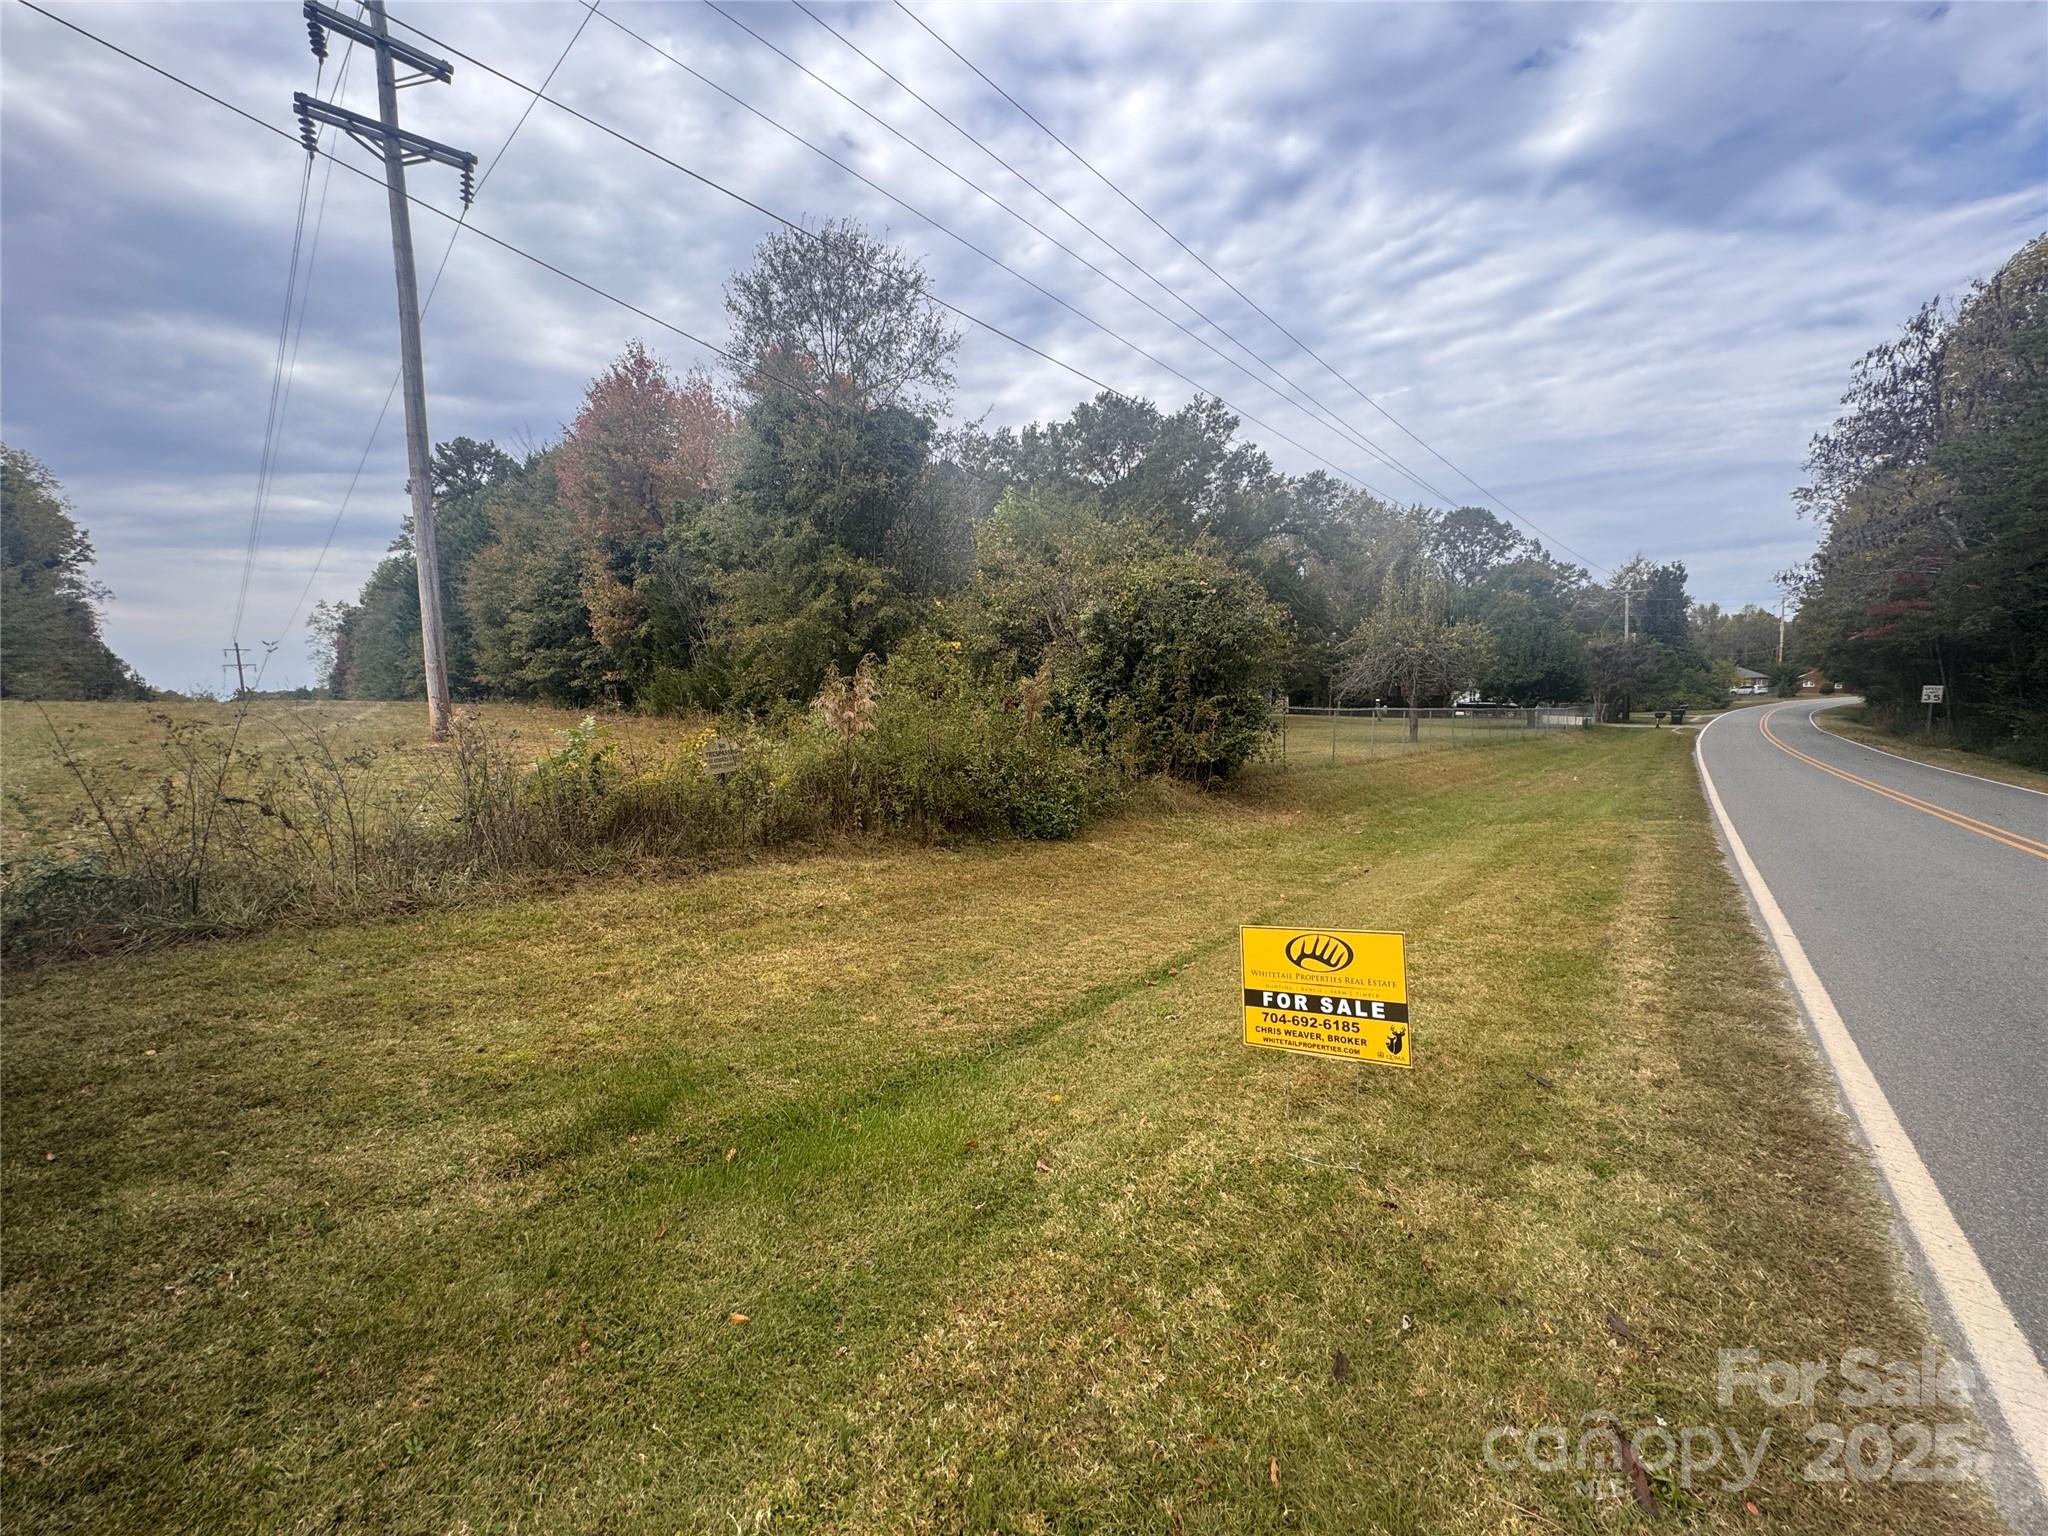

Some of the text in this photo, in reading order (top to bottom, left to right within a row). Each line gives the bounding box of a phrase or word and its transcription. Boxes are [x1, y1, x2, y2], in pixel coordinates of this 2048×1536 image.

[1250, 969, 1397, 988] WHITETAIL PROPERTIES REAL ESTATE
[1262, 991, 1386, 1019] FOR SALE
[1261, 1011, 1361, 1033] 704-692-6185
[1255, 1025, 1368, 1047] CHRIS WEAVER, BROKER
[1262, 1036, 1361, 1055] WHITETAILPROPERTIES.COM
